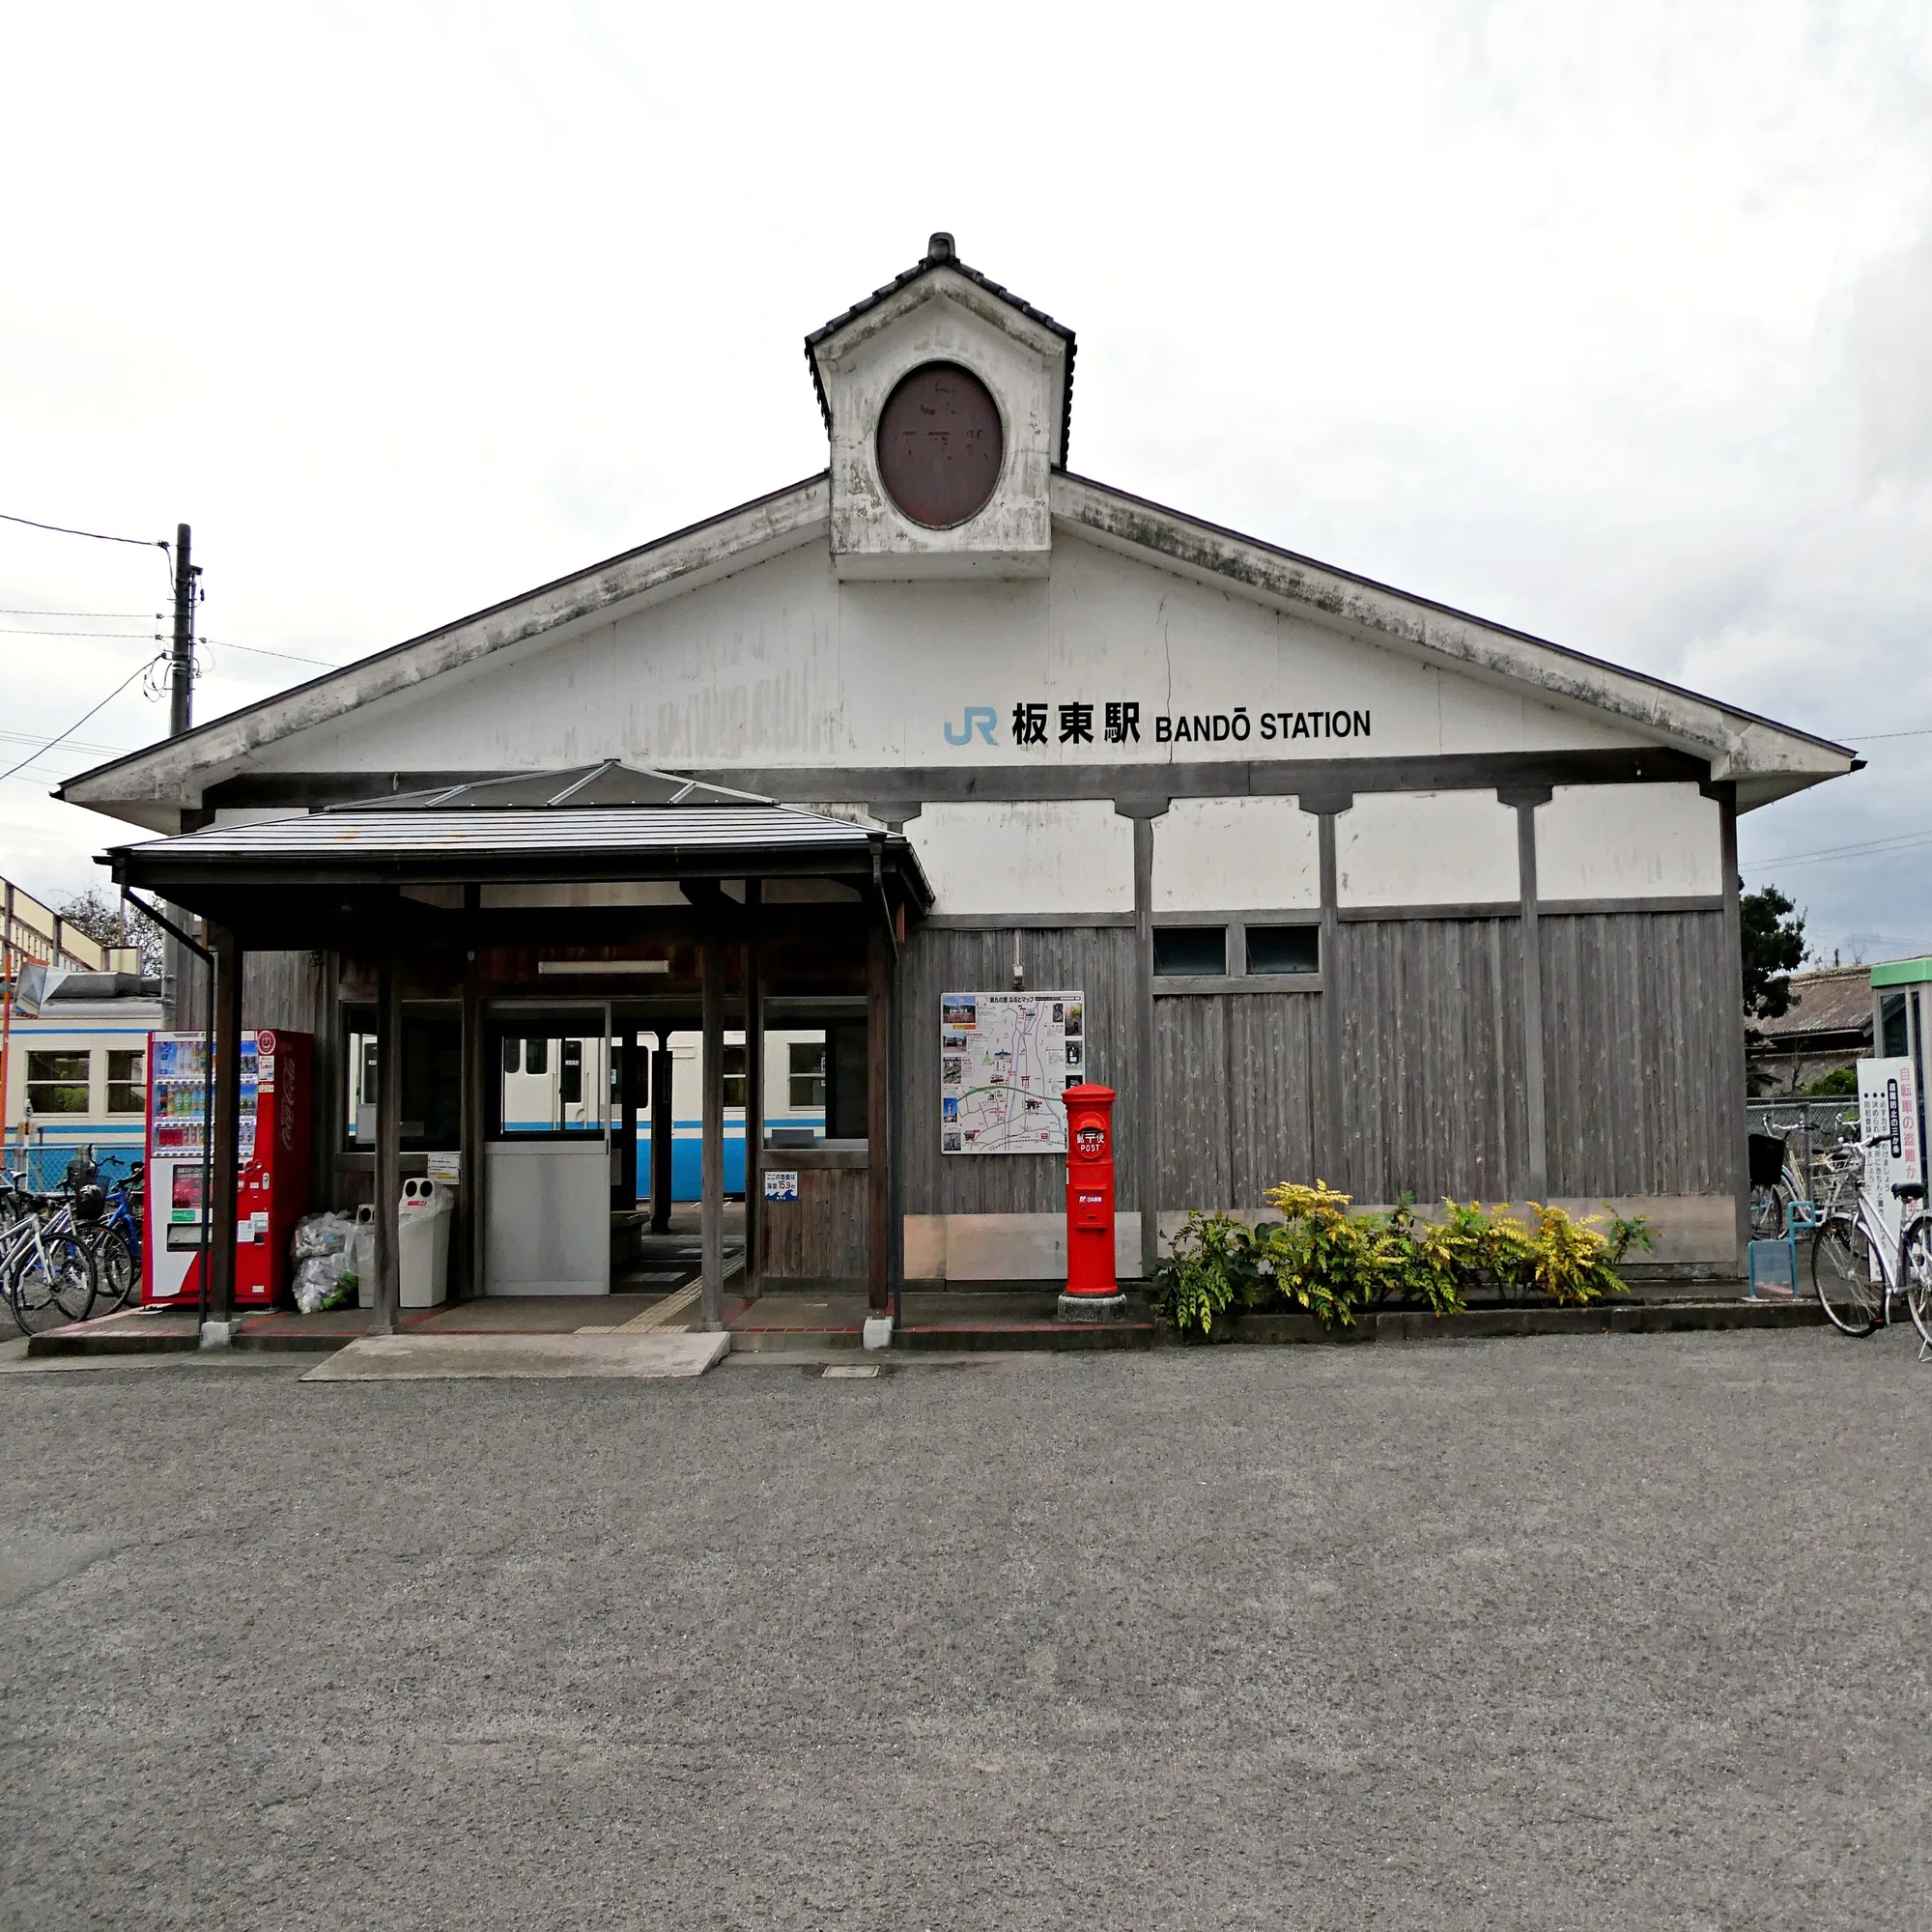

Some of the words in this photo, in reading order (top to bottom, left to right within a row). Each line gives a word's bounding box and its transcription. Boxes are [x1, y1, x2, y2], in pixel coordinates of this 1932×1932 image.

[944, 706, 998, 746] JR
[1011, 701, 1141, 745] 板東駅
[1155, 707, 1251, 742] BANDŌ
[1260, 710, 1371, 740] STATION
[1080, 1144, 1100, 1152] POST
[1899, 1066, 1919, 1212] 自転車の盗難が発
